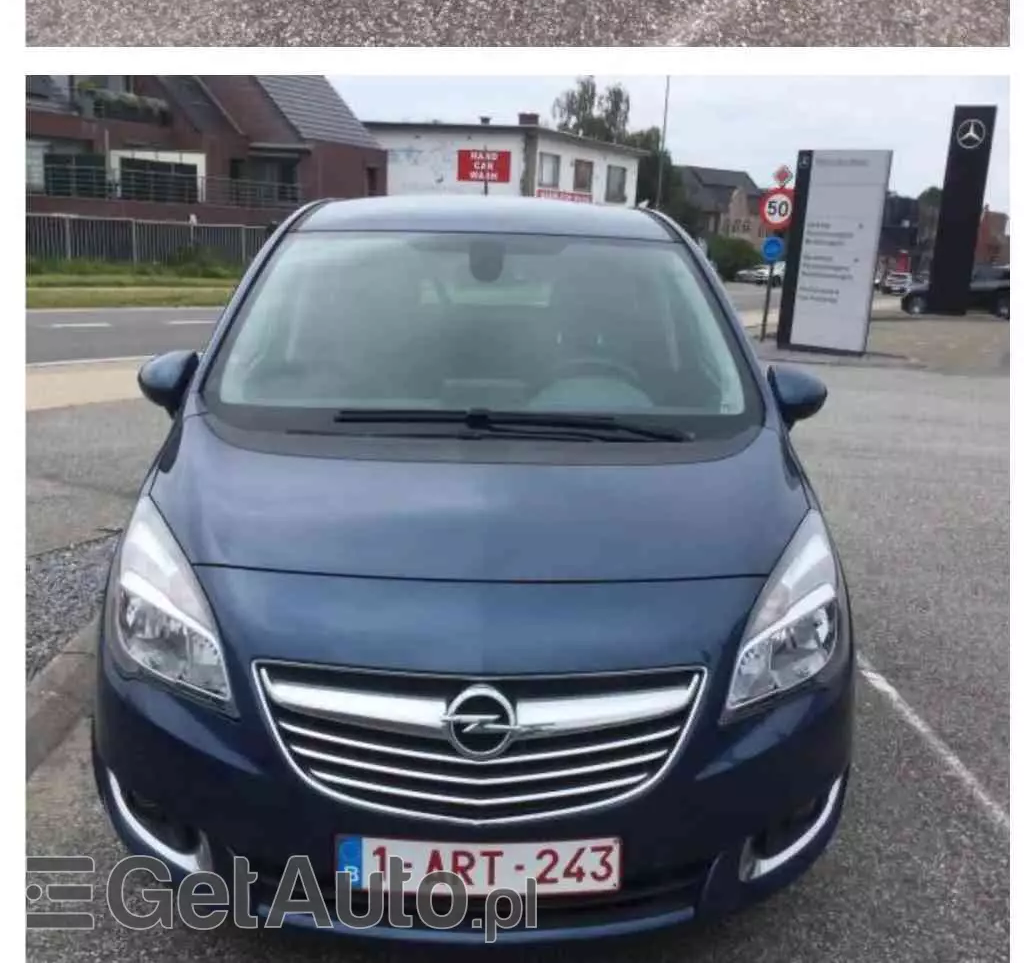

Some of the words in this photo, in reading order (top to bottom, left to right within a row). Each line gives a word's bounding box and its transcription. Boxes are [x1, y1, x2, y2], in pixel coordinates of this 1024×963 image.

[469, 152, 498, 161] HAND
[473, 161, 494, 171] CAR
[767, 200, 790, 218] 50
